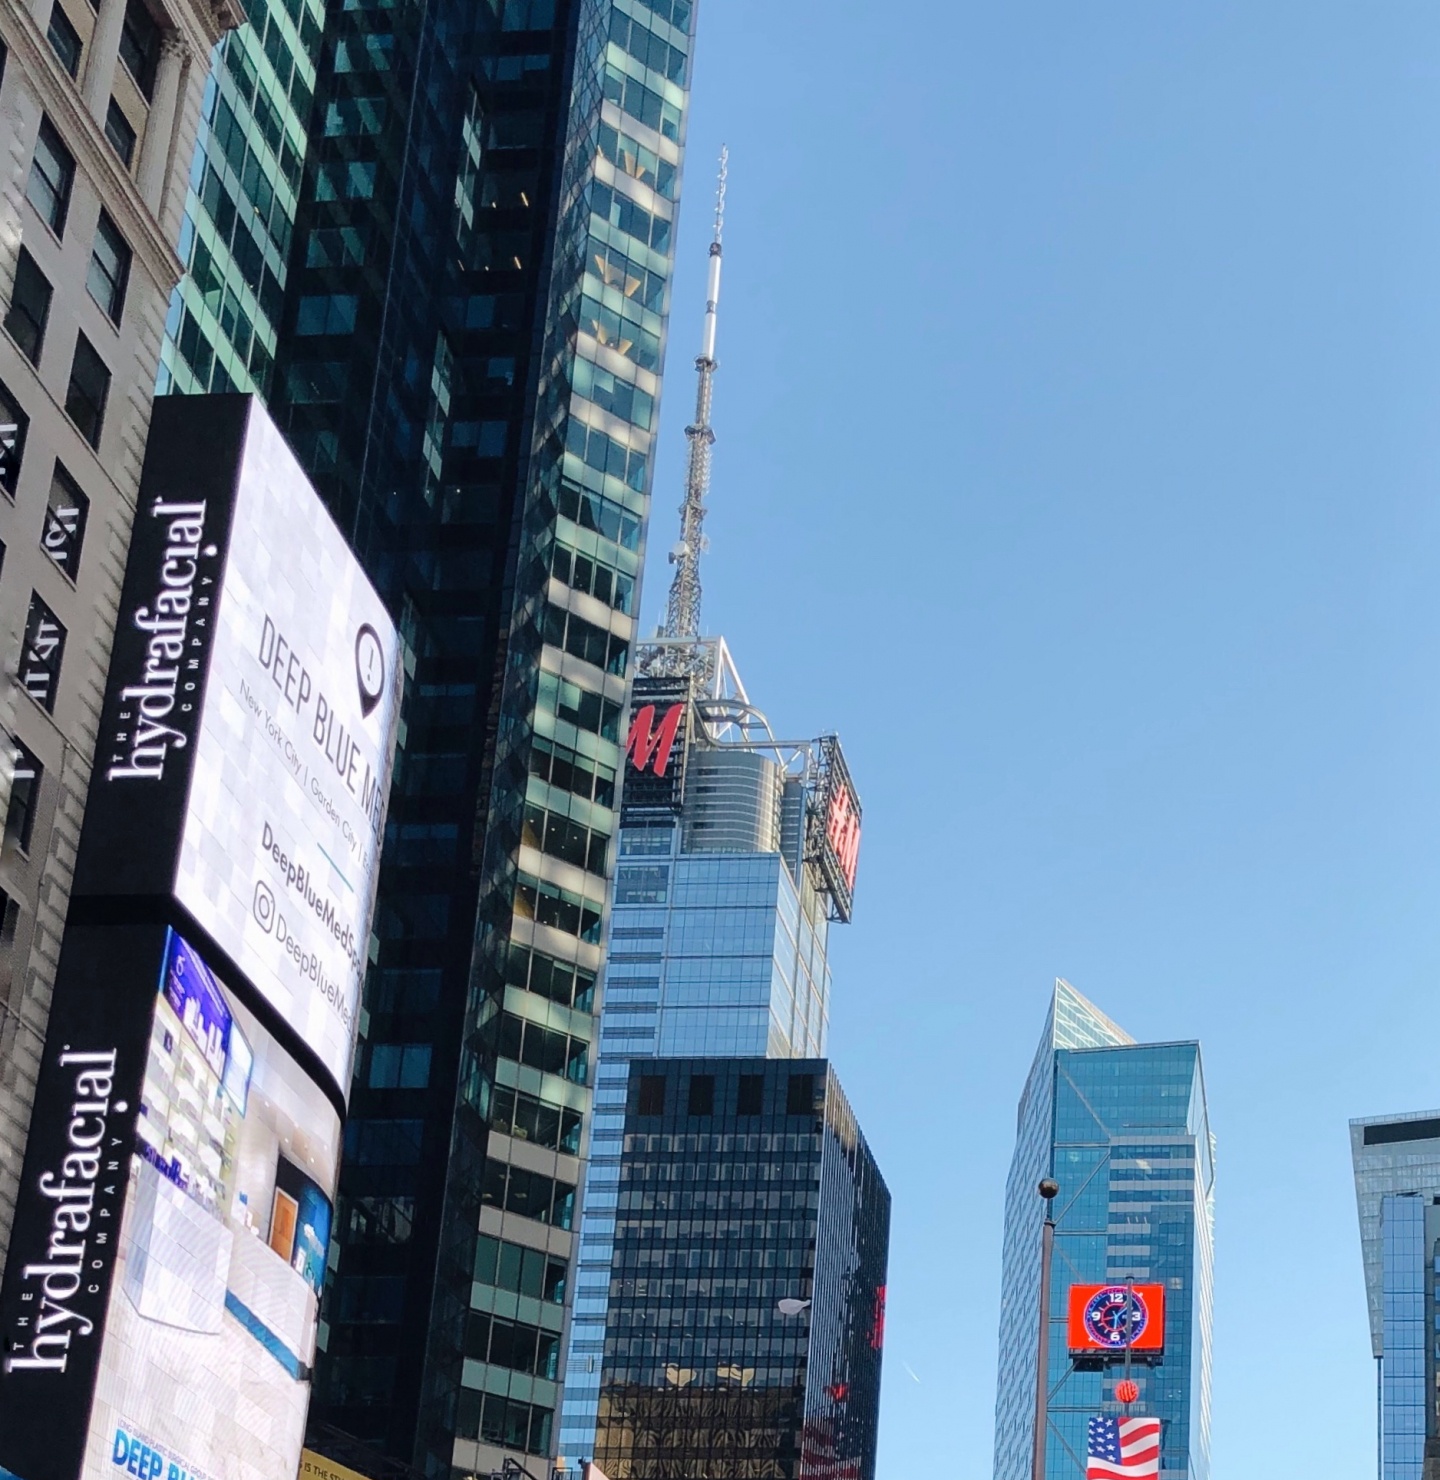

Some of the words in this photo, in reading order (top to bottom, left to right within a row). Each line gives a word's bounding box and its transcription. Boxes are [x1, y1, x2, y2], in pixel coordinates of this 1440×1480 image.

[109, 499, 207, 780] hydrafacial
[182, 577, 212, 713] COMPANY
[113, 711, 130, 762] THE
[258, 614, 311, 714] DEEP
[313, 692, 360, 795] BLUE
[240, 678, 262, 716] New
[264, 710, 283, 747] York
[285, 740, 303, 777] City
[311, 777, 341, 828] Garden
[342, 820, 357, 853] City
[6, 1048, 116, 1373] hydrafacial
[88, 1138, 122, 1293] COMPANY
[14, 1293, 33, 1350] THE
[1091, 1311, 1101, 1321] 9
[1132, 1311, 1141, 1321] 3
[1109, 1293, 1123, 1302] 12
[1110, 1332, 1120, 1341] 6
[304, 1462, 312, 1473] IS
[314, 1465, 329, 1480] THE
